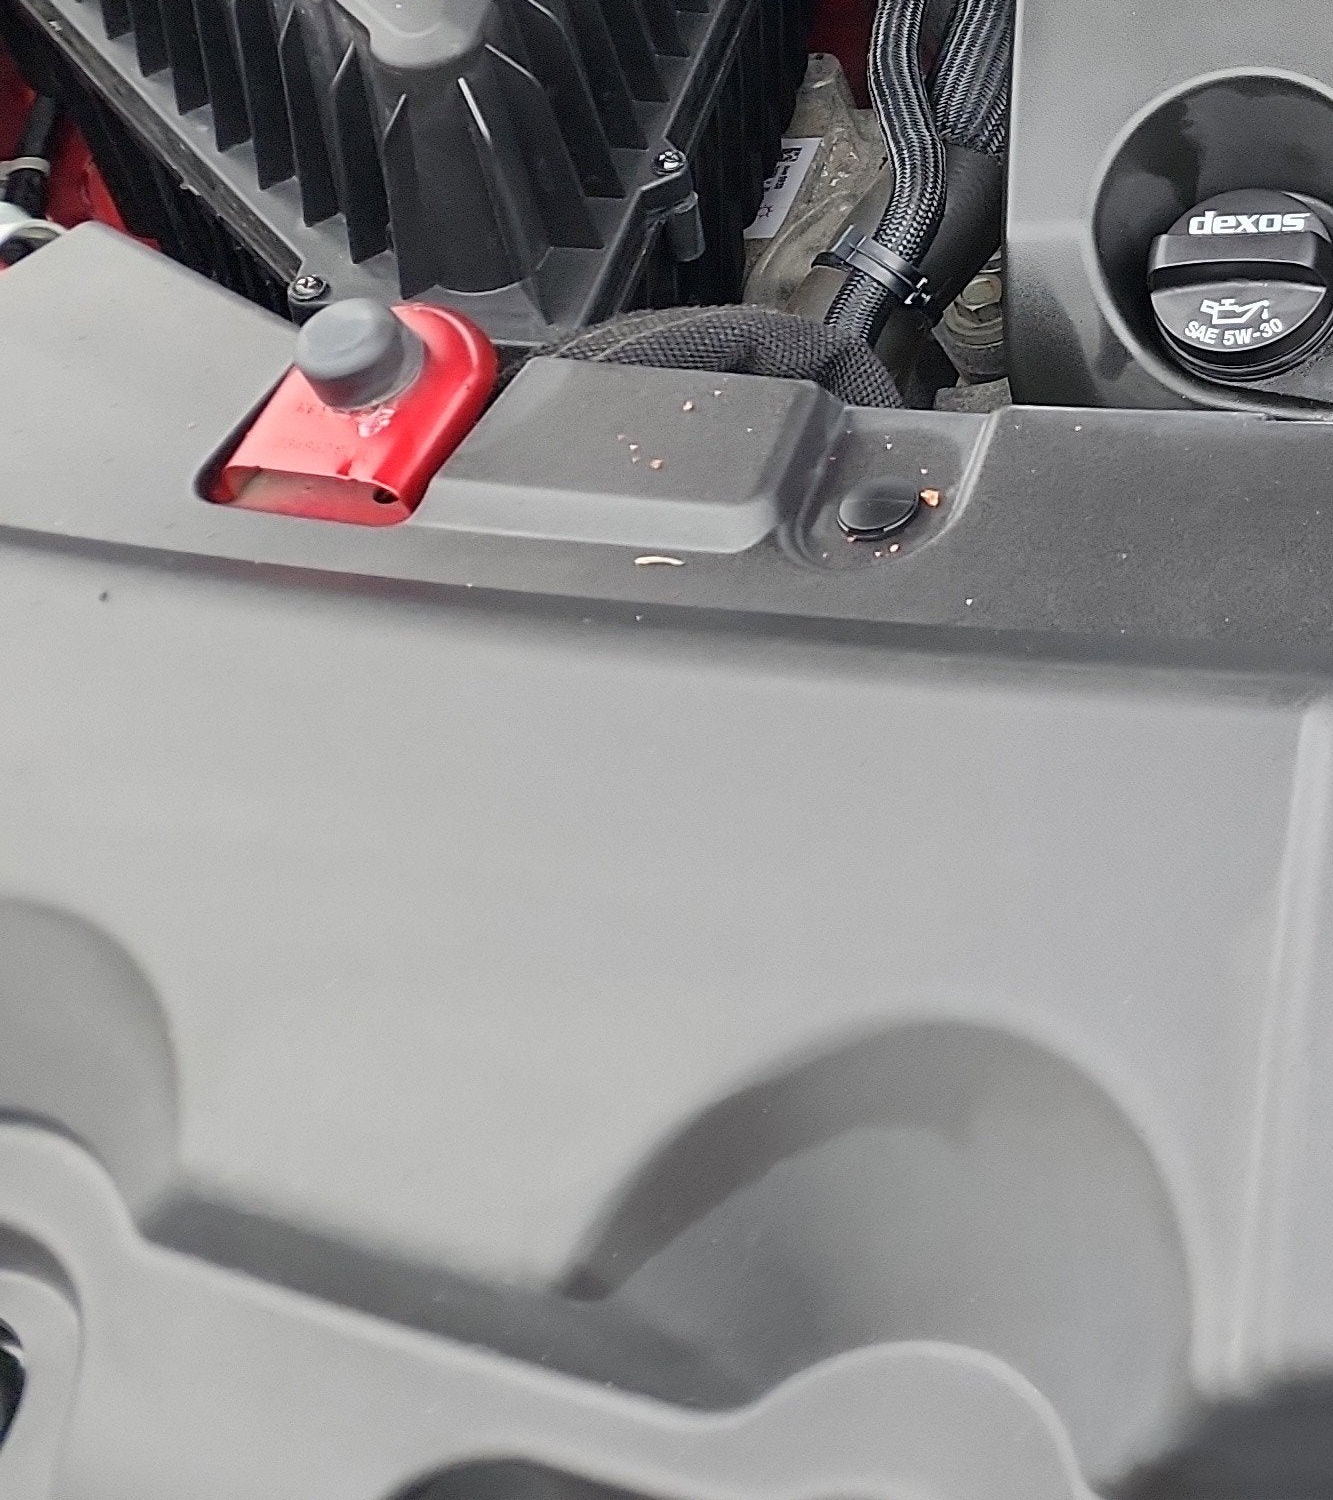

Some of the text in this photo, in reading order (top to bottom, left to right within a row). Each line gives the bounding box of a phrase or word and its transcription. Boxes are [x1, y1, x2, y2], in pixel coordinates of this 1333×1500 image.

[1188, 209, 1311, 234] dexos
[1184, 317, 1283, 346] SAE 5W-30
